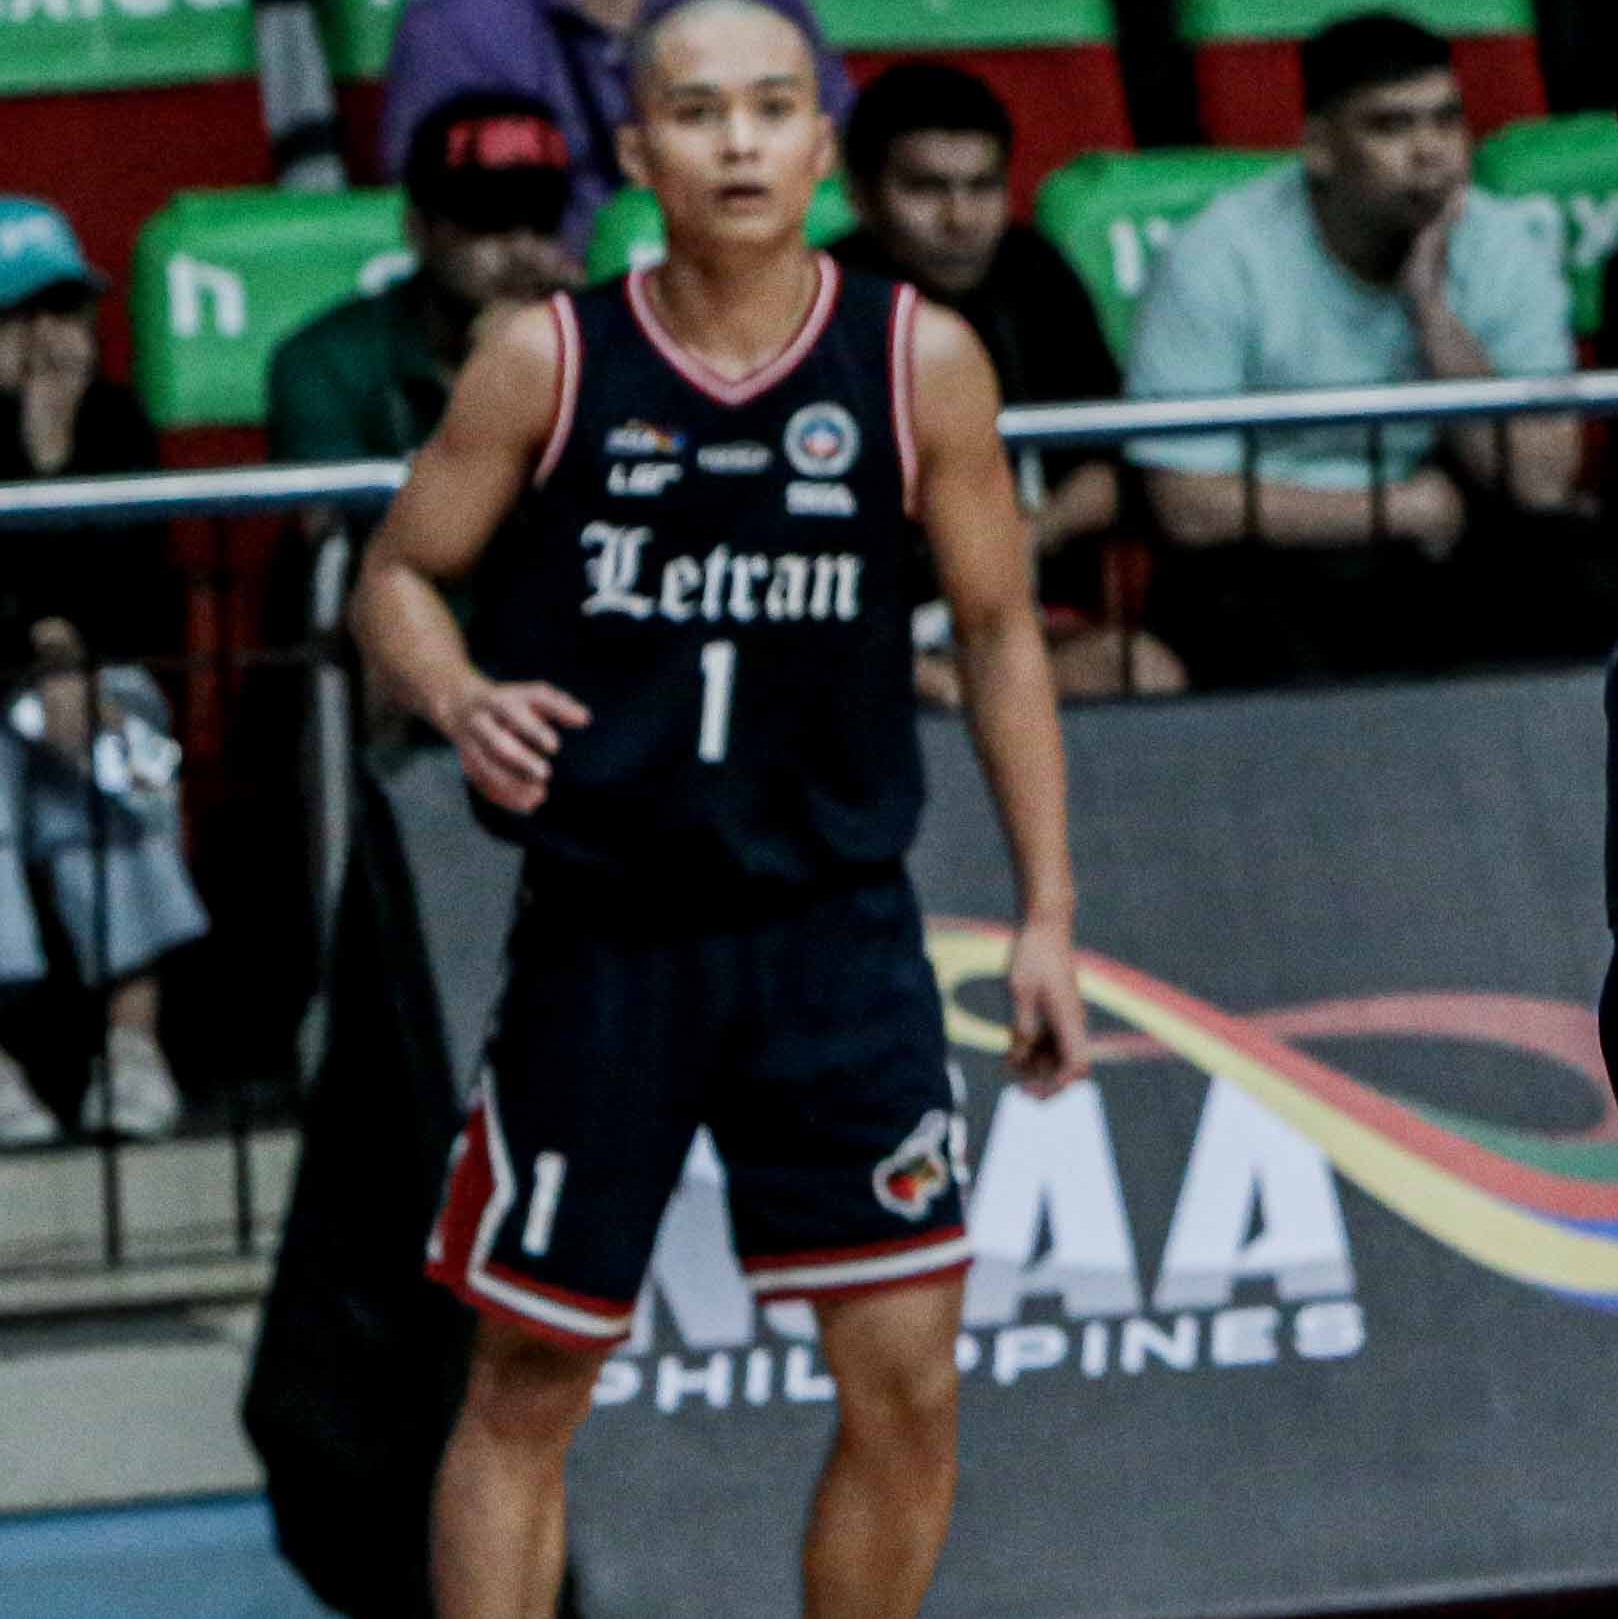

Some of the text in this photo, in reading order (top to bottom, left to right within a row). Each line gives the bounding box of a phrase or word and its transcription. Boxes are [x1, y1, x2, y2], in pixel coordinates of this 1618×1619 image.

[580, 519, 863, 623] Letran
[698, 639, 736, 763] 1
[521, 1151, 566, 1255] 1
